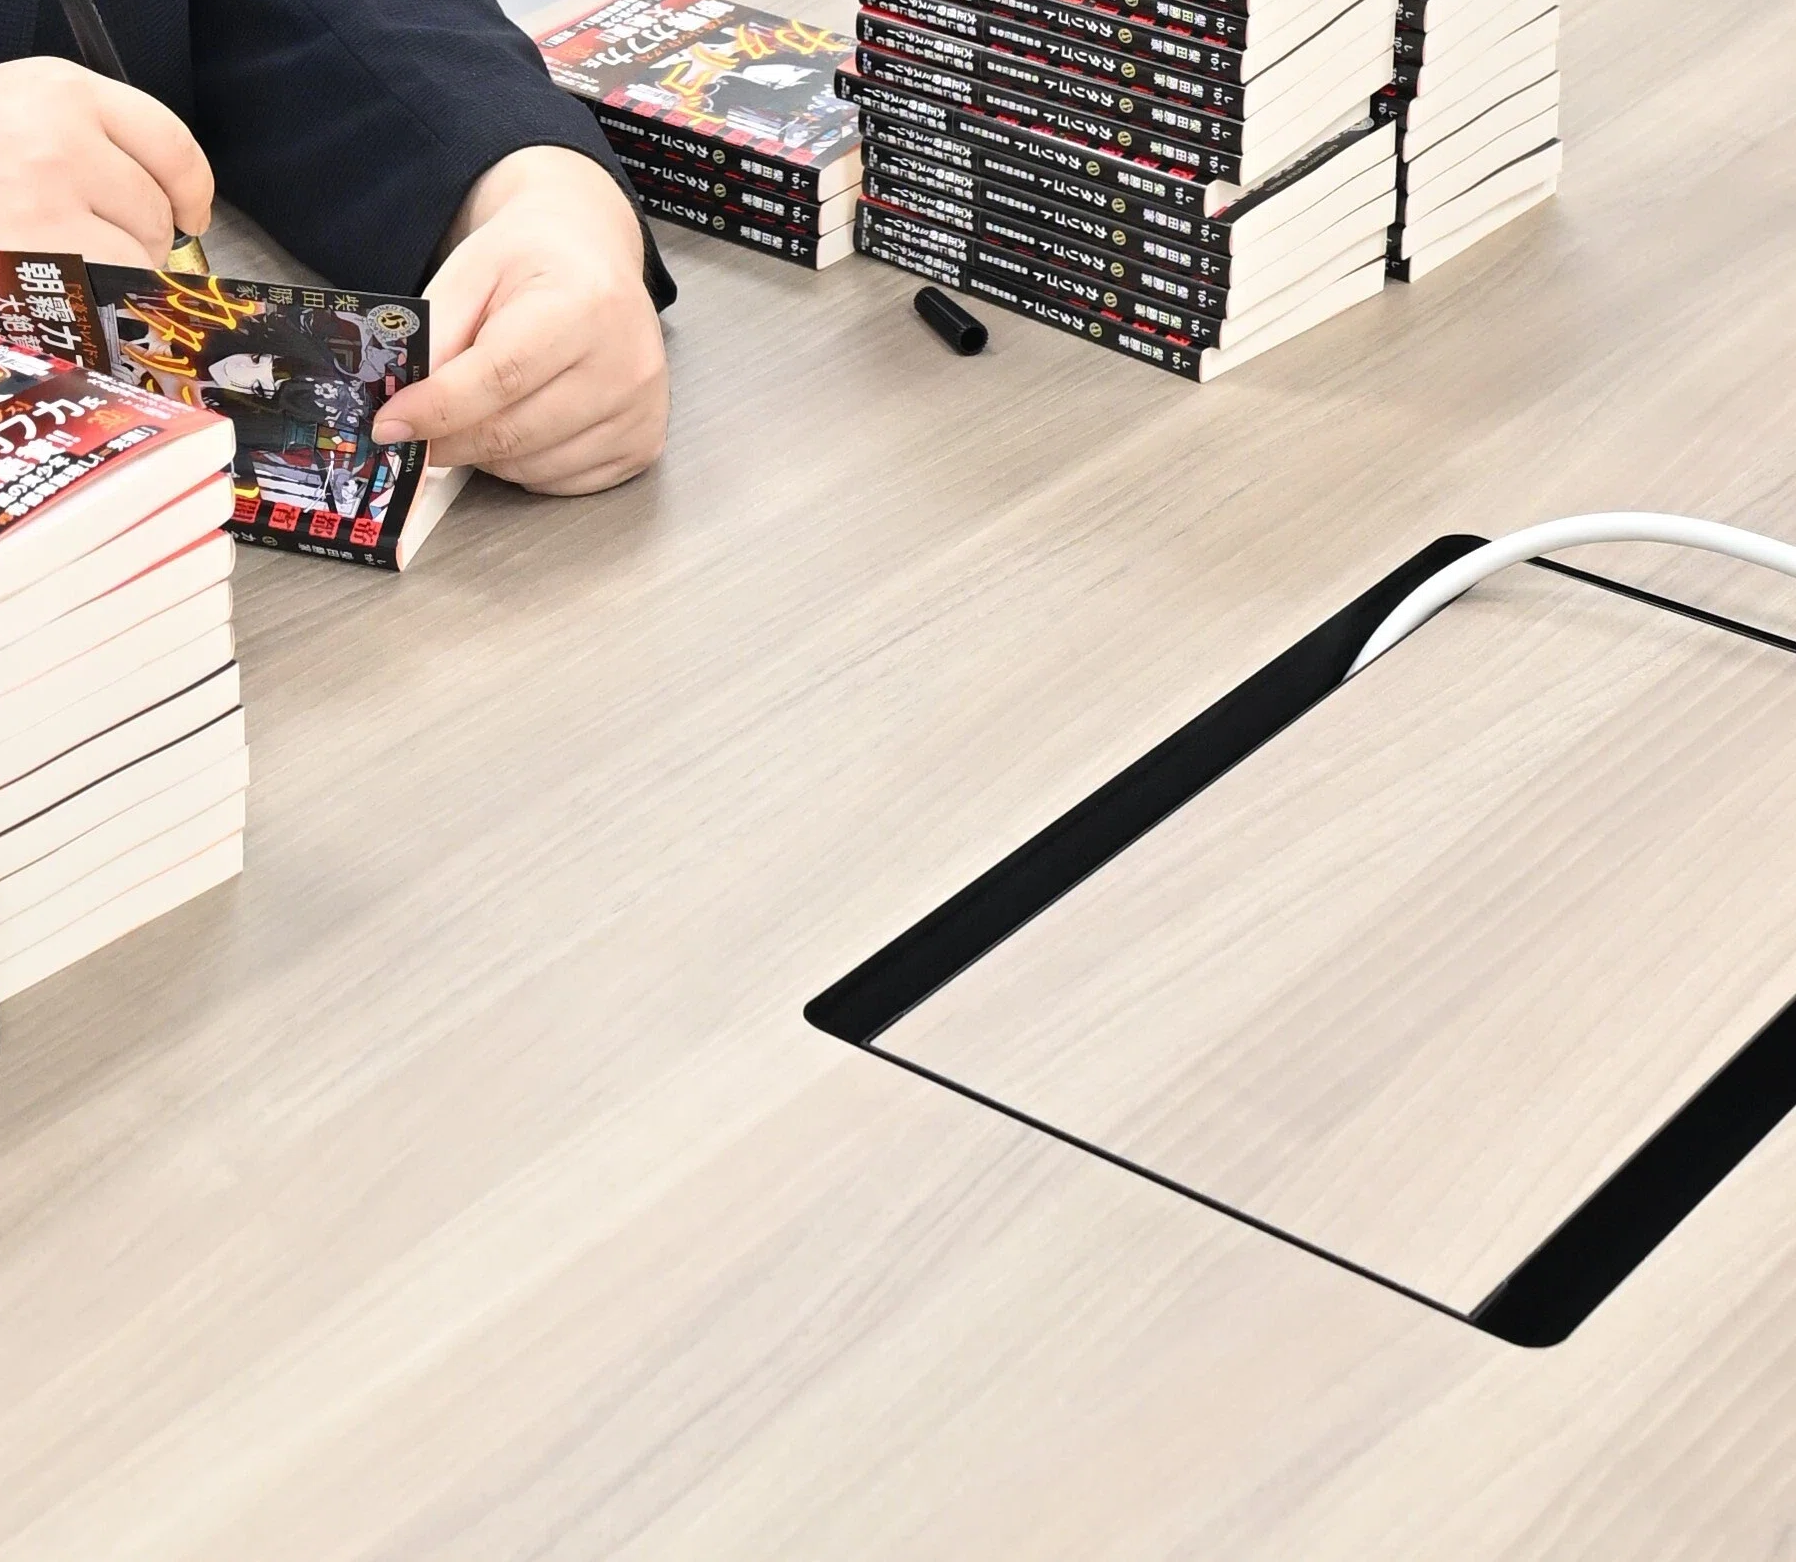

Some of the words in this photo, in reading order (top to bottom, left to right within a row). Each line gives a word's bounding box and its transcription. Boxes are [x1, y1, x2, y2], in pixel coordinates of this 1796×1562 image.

[1043, 10, 1113, 38] カタリゴト
[660, 18, 850, 125] カタリゴト
[1046, 44, 1116, 72] カタリゴト
[1044, 79, 1114, 107] カタリゴト
[1043, 112, 1113, 140] カタリゴト
[649, 131, 709, 158] カタリゴト
[1014, 141, 1082, 170] カタリゴト
[650, 166, 710, 192] カタリゴト
[1039, 178, 1107, 207] カタリゴト
[649, 198, 708, 224] カタリゴト
[1040, 210, 1108, 239] カタリゴト
[1039, 241, 1106, 271] カタリゴト
[236, 284, 359, 311] 柴田勝家
[1032, 272, 1099, 301] カタリゴト
[1022, 300, 1085, 330] カタリゴト
